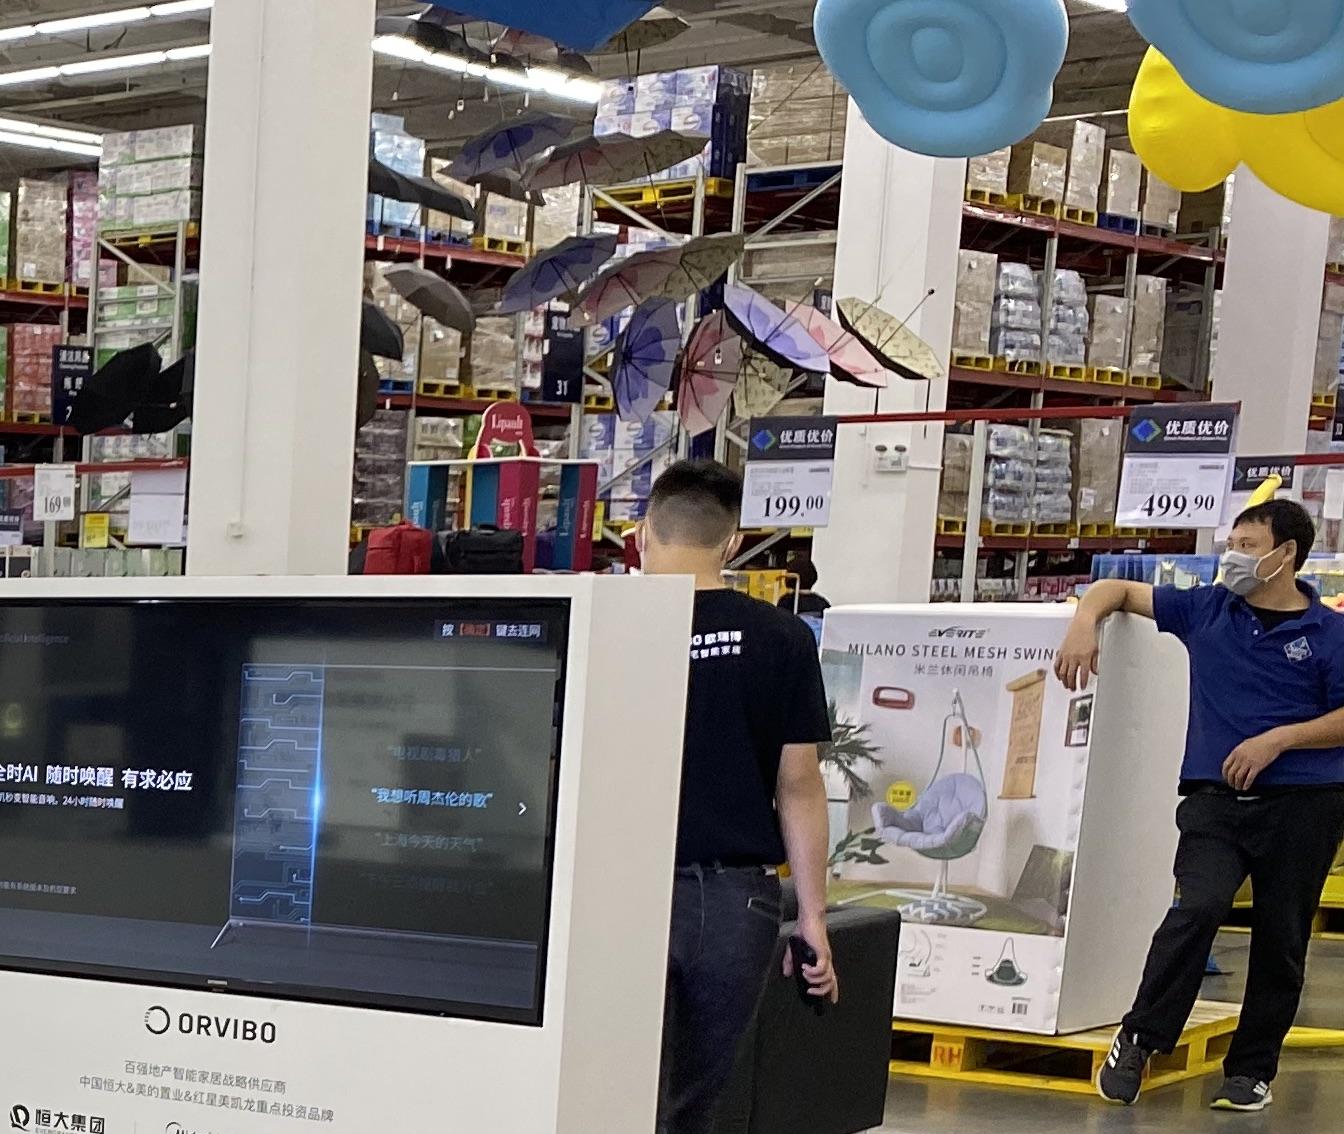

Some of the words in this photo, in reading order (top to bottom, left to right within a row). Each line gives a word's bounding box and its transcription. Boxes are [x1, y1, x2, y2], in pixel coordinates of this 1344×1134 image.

[780, 429, 833, 443] 优质优价
[1165, 420, 1229, 435] 优质优价
[764, 495, 824, 518] 199.00
[1141, 494, 1215, 518] 499.90
[442, 623, 454, 637] 按
[848, 643, 906, 657] MILANO
[912, 644, 958, 658] STEEL
[964, 646, 1008, 660] MESH
[1013, 648, 1061, 662] SWIN
[45, 765, 114, 788] 随时唤醒
[121, 768, 193, 792] 有求必应
[177, 1011, 277, 1045] ORVIBO
[124, 1059, 288, 1095] 百强地产智能家居战略供应商
[78, 1075, 336, 1123] 中国恒大&美的置业&红星美凯龙重点投资品牌
